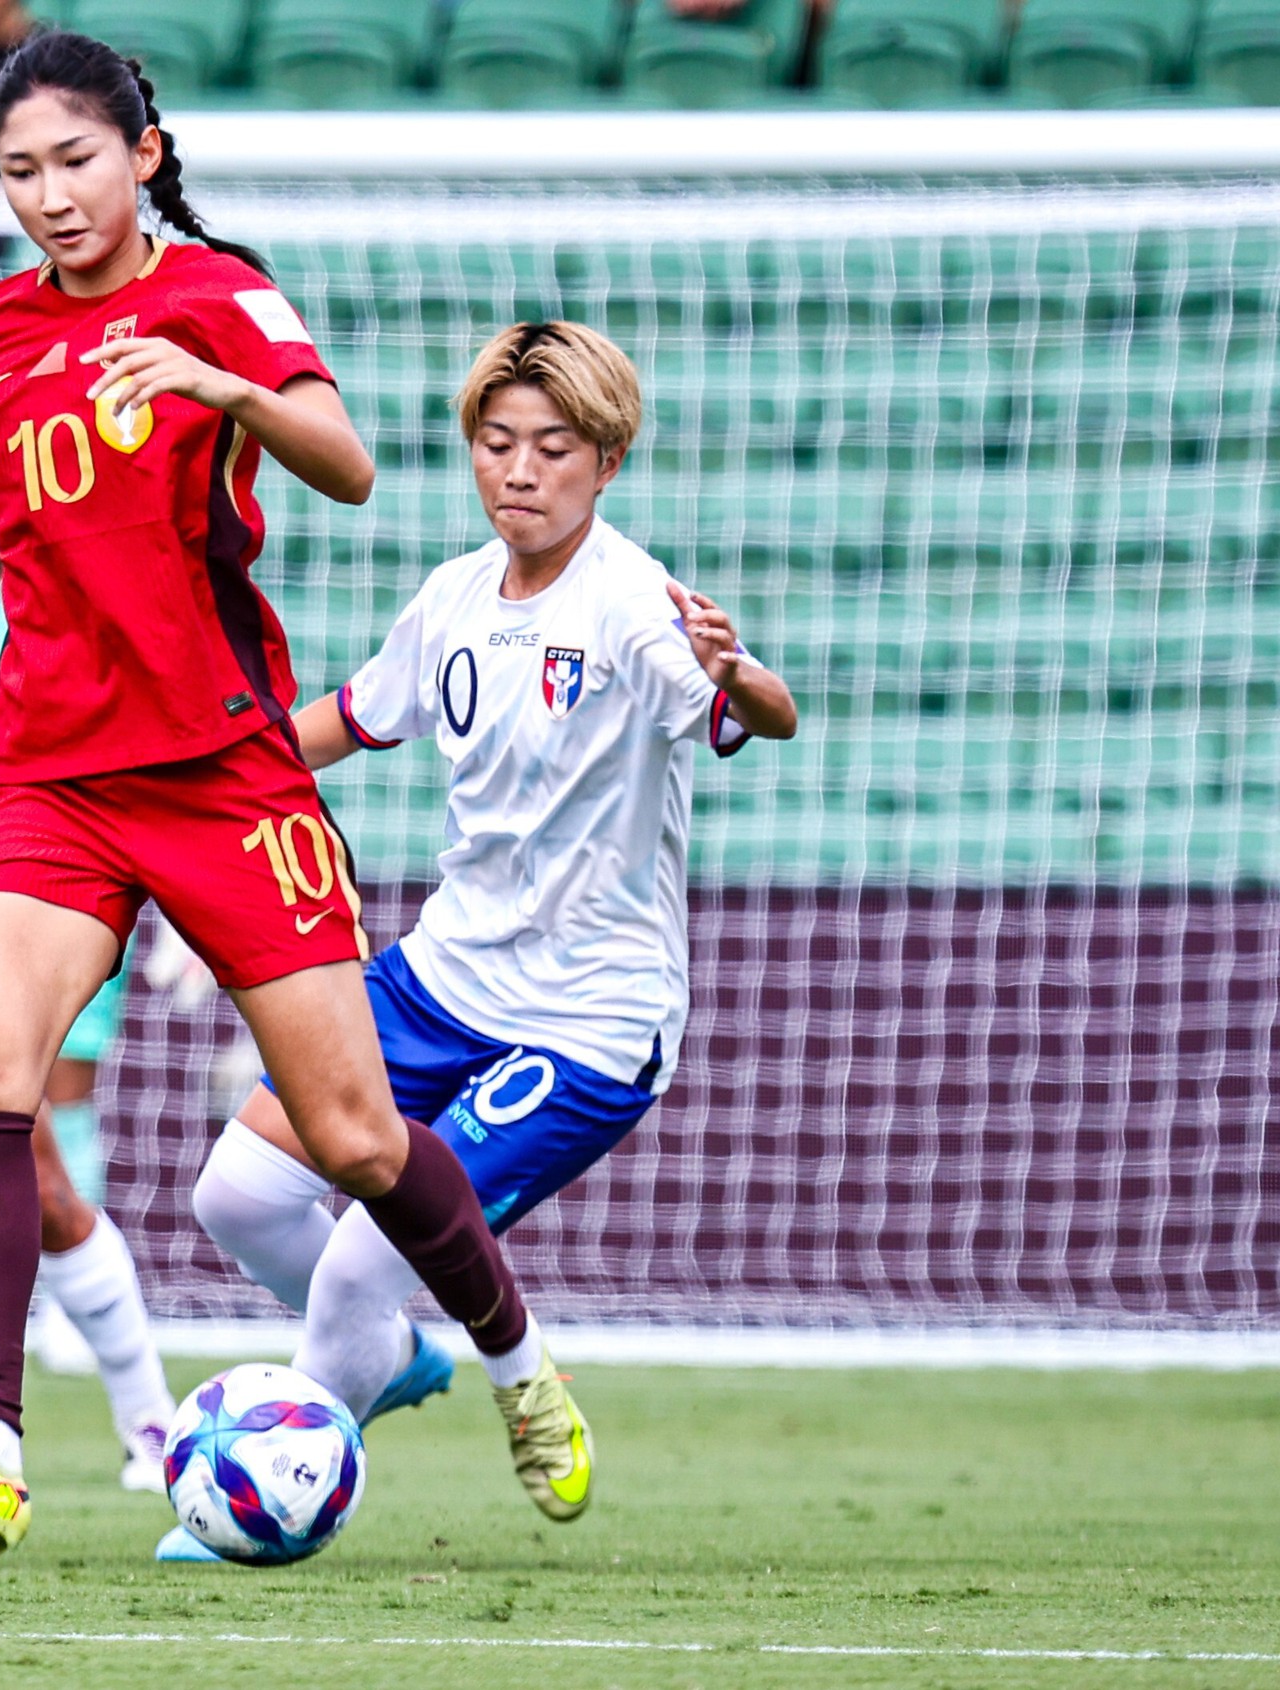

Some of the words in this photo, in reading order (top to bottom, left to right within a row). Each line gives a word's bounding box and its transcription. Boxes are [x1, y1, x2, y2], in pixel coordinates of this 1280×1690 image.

[7, 413, 95, 512] 10
[489, 633, 540, 646] ENTES
[546, 649, 581, 660] CTFA
[436, 647, 478, 737] 0
[242, 812, 334, 906] 10
